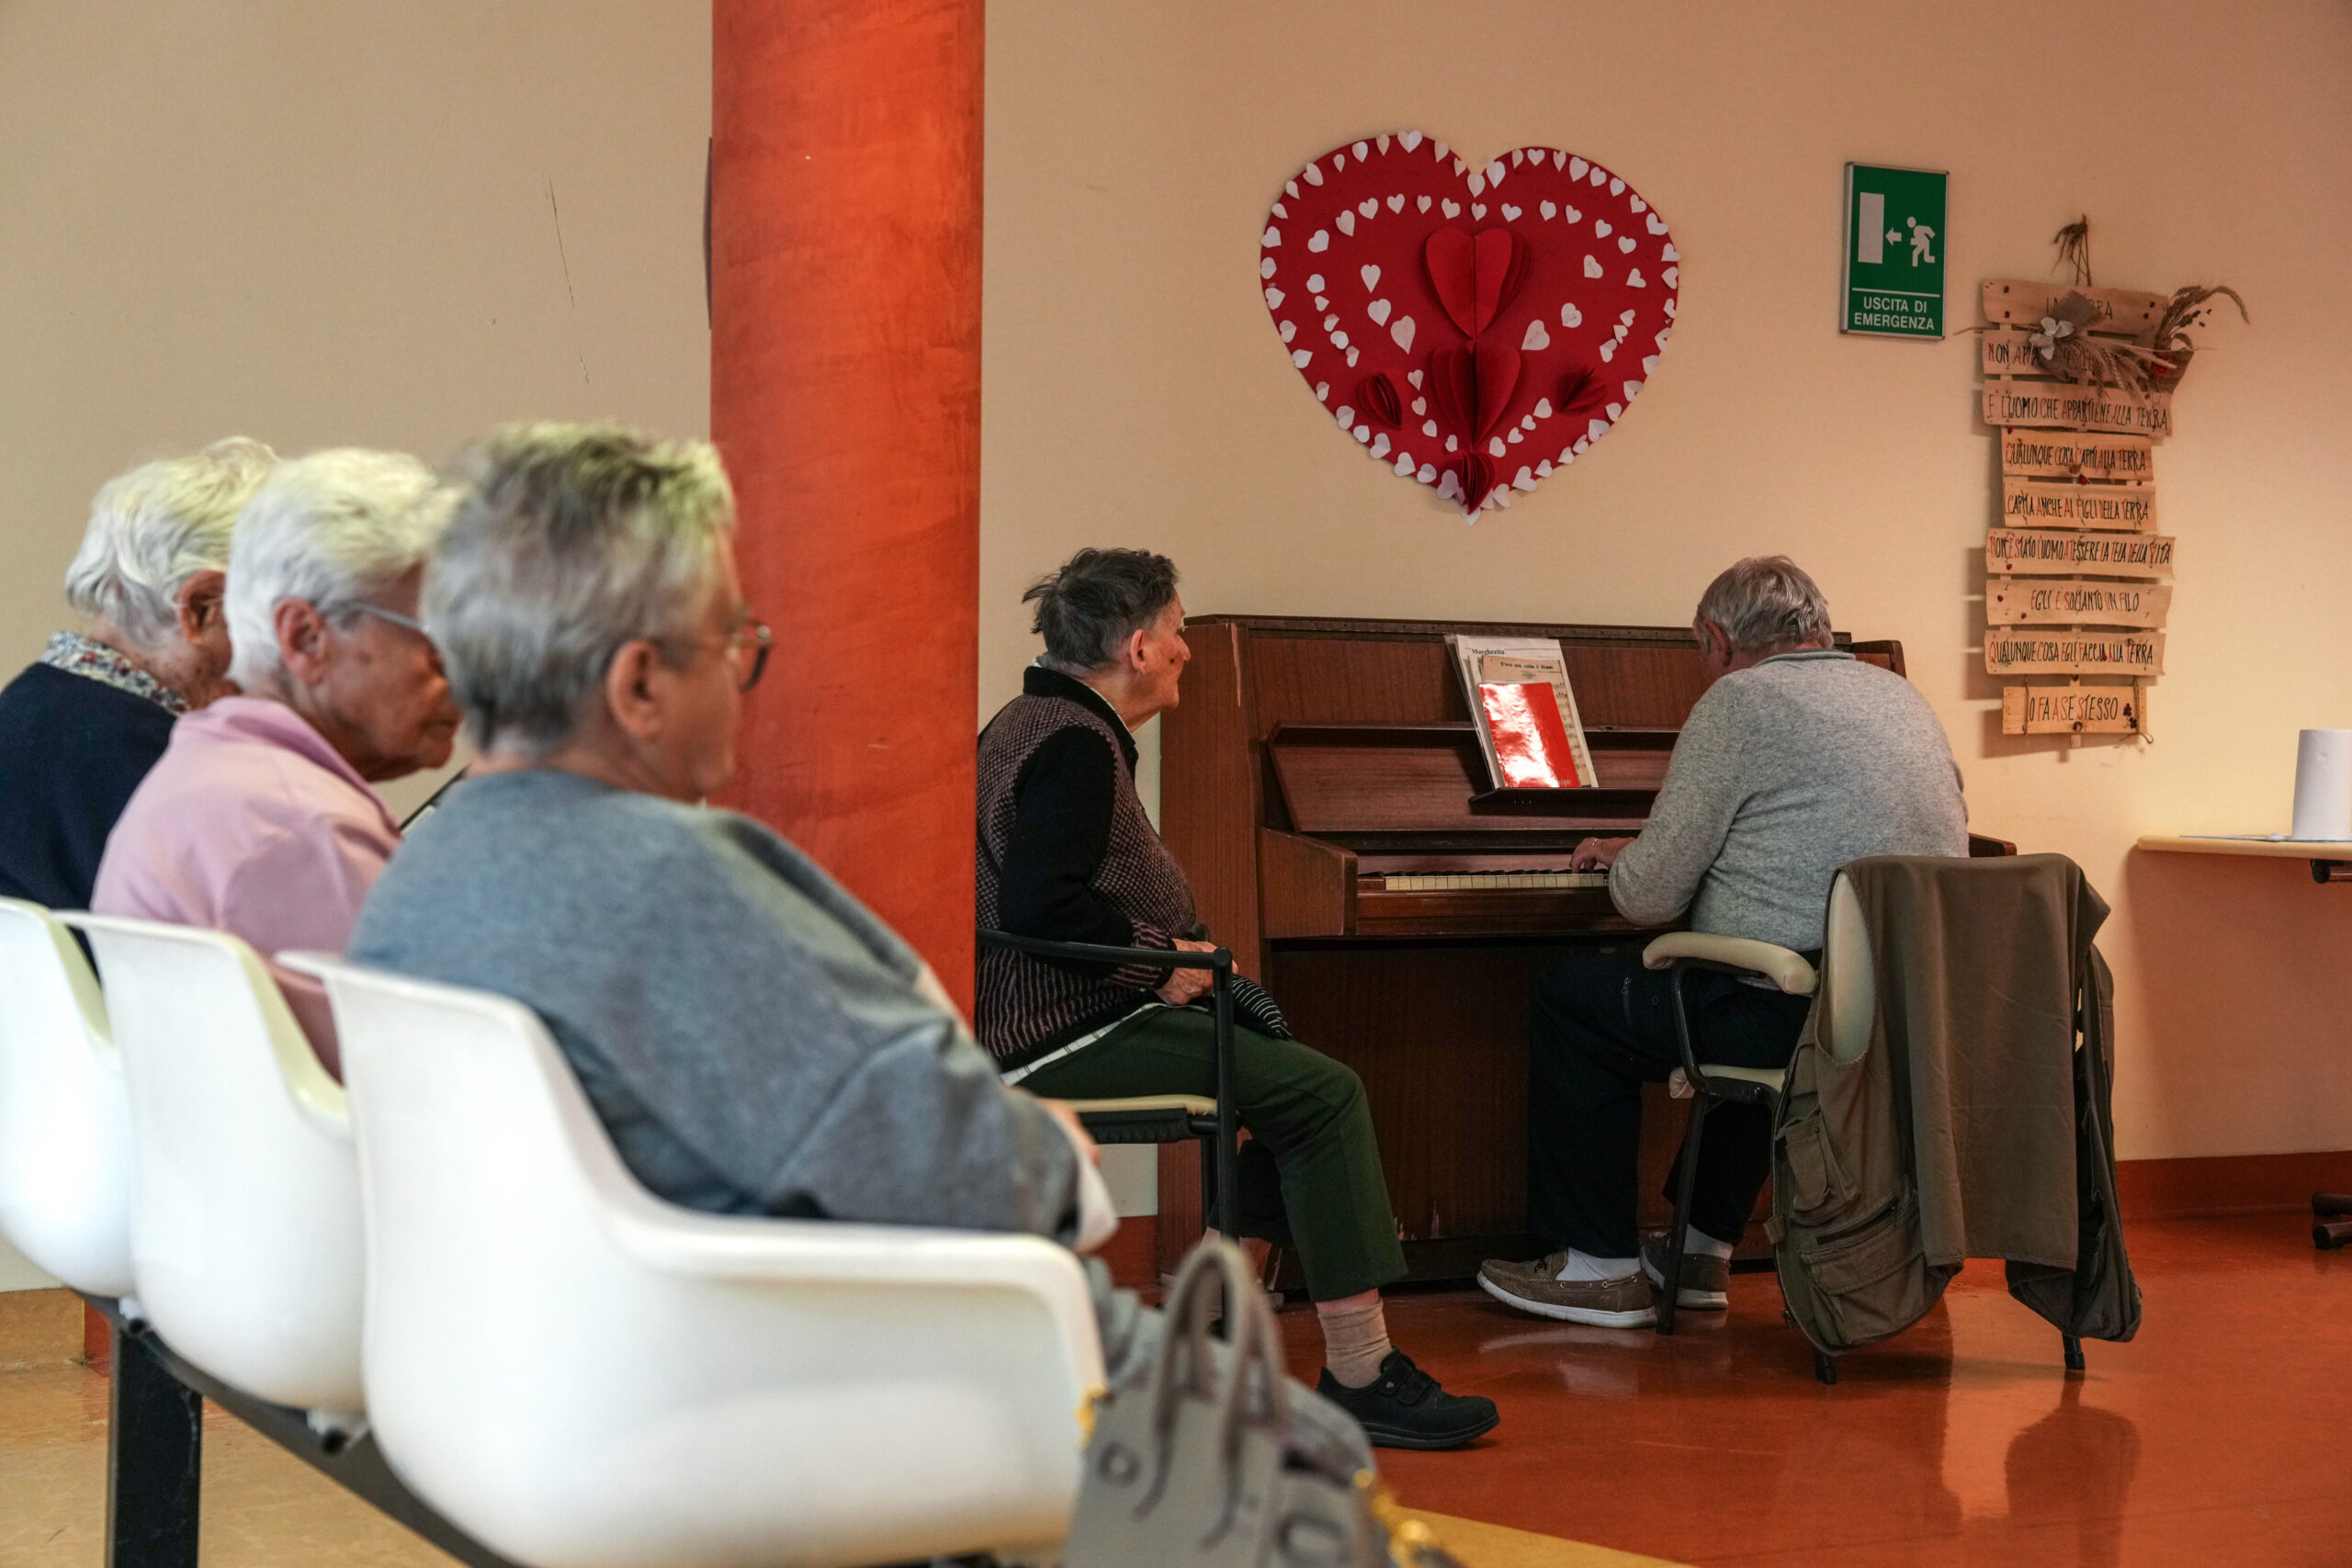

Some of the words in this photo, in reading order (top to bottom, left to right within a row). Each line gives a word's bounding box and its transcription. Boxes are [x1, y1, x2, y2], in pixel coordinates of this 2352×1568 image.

[1863, 296, 1909, 312] USCITA
[1914, 300, 1927, 313] DI
[1854, 311, 1935, 331] EMERGENZA
[1988, 343, 2009, 364] NON
[2001, 389, 2038, 419] L'UOMO
[2040, 398, 2059, 420] CHE
[2062, 398, 2111, 423] APPARTIENE
[2110, 404, 2132, 426] ALLA
[2136, 406, 2167, 431] TERRA
[2006, 443, 2053, 467] QUALUNQUE
[2055, 446, 2074, 467] COSA
[2097, 449, 2115, 469] ALLA
[2116, 448, 2146, 471] TERRA
[2007, 493, 2035, 516] CAPITA
[2036, 496, 2063, 517] ANCHE
[2064, 496, 2074, 518] AI
[2076, 499, 2098, 519] FIGLI
[2098, 499, 2120, 520] DELLA
[2121, 498, 2148, 521] TERRA
[1989, 536, 2007, 558] NON
[2015, 536, 2036, 559] STATO
[2037, 536, 2064, 560] L'UOMO
[2068, 538, 2100, 561] TESSERE
[2100, 541, 2109, 561] LA
[2110, 541, 2127, 563] TELA
[2127, 542, 2148, 564] DELLA
[2149, 542, 2171, 564] VITA
[2030, 589, 2052, 611] EGLI
[2064, 589, 2103, 612] SOLTANTO
[2104, 591, 2118, 611] UN
[2119, 592, 2140, 612] FILO
[1472, 648, 1505, 656] Margherita
[1988, 640, 2036, 663] QUALUNQUE
[2037, 641, 2059, 662] COSA
[2061, 641, 2076, 662] EGLI
[2078, 642, 2107, 662] FACCIA
[2109, 642, 2123, 662] ALLA
[2125, 641, 2154, 665] TERRA
[2037, 696, 2050, 721] FA
[2052, 696, 2059, 721] A
[2077, 694, 2119, 721] STESSO
